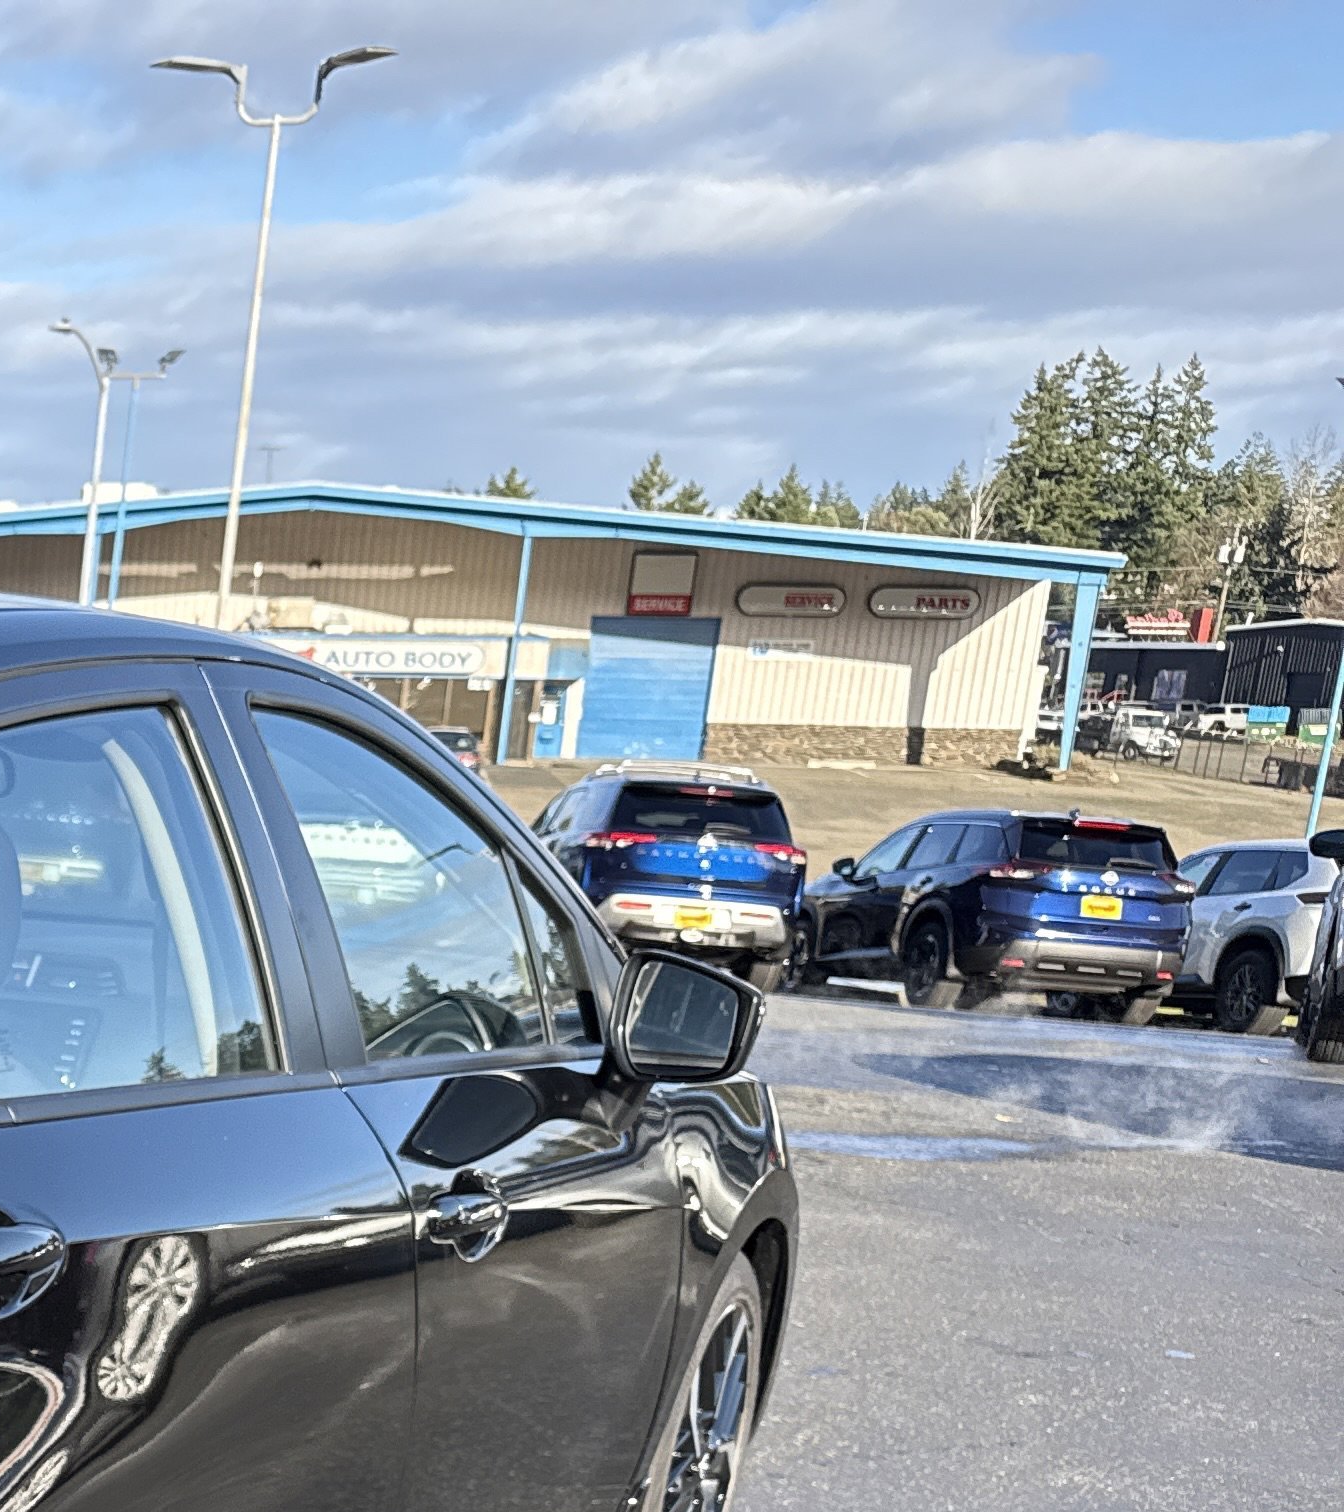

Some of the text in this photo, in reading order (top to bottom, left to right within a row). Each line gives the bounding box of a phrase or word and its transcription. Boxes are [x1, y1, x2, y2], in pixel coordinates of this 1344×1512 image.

[632, 596, 687, 611] SERVICE
[916, 594, 970, 610] PARTS
[325, 650, 473, 669] AUTO BODY
